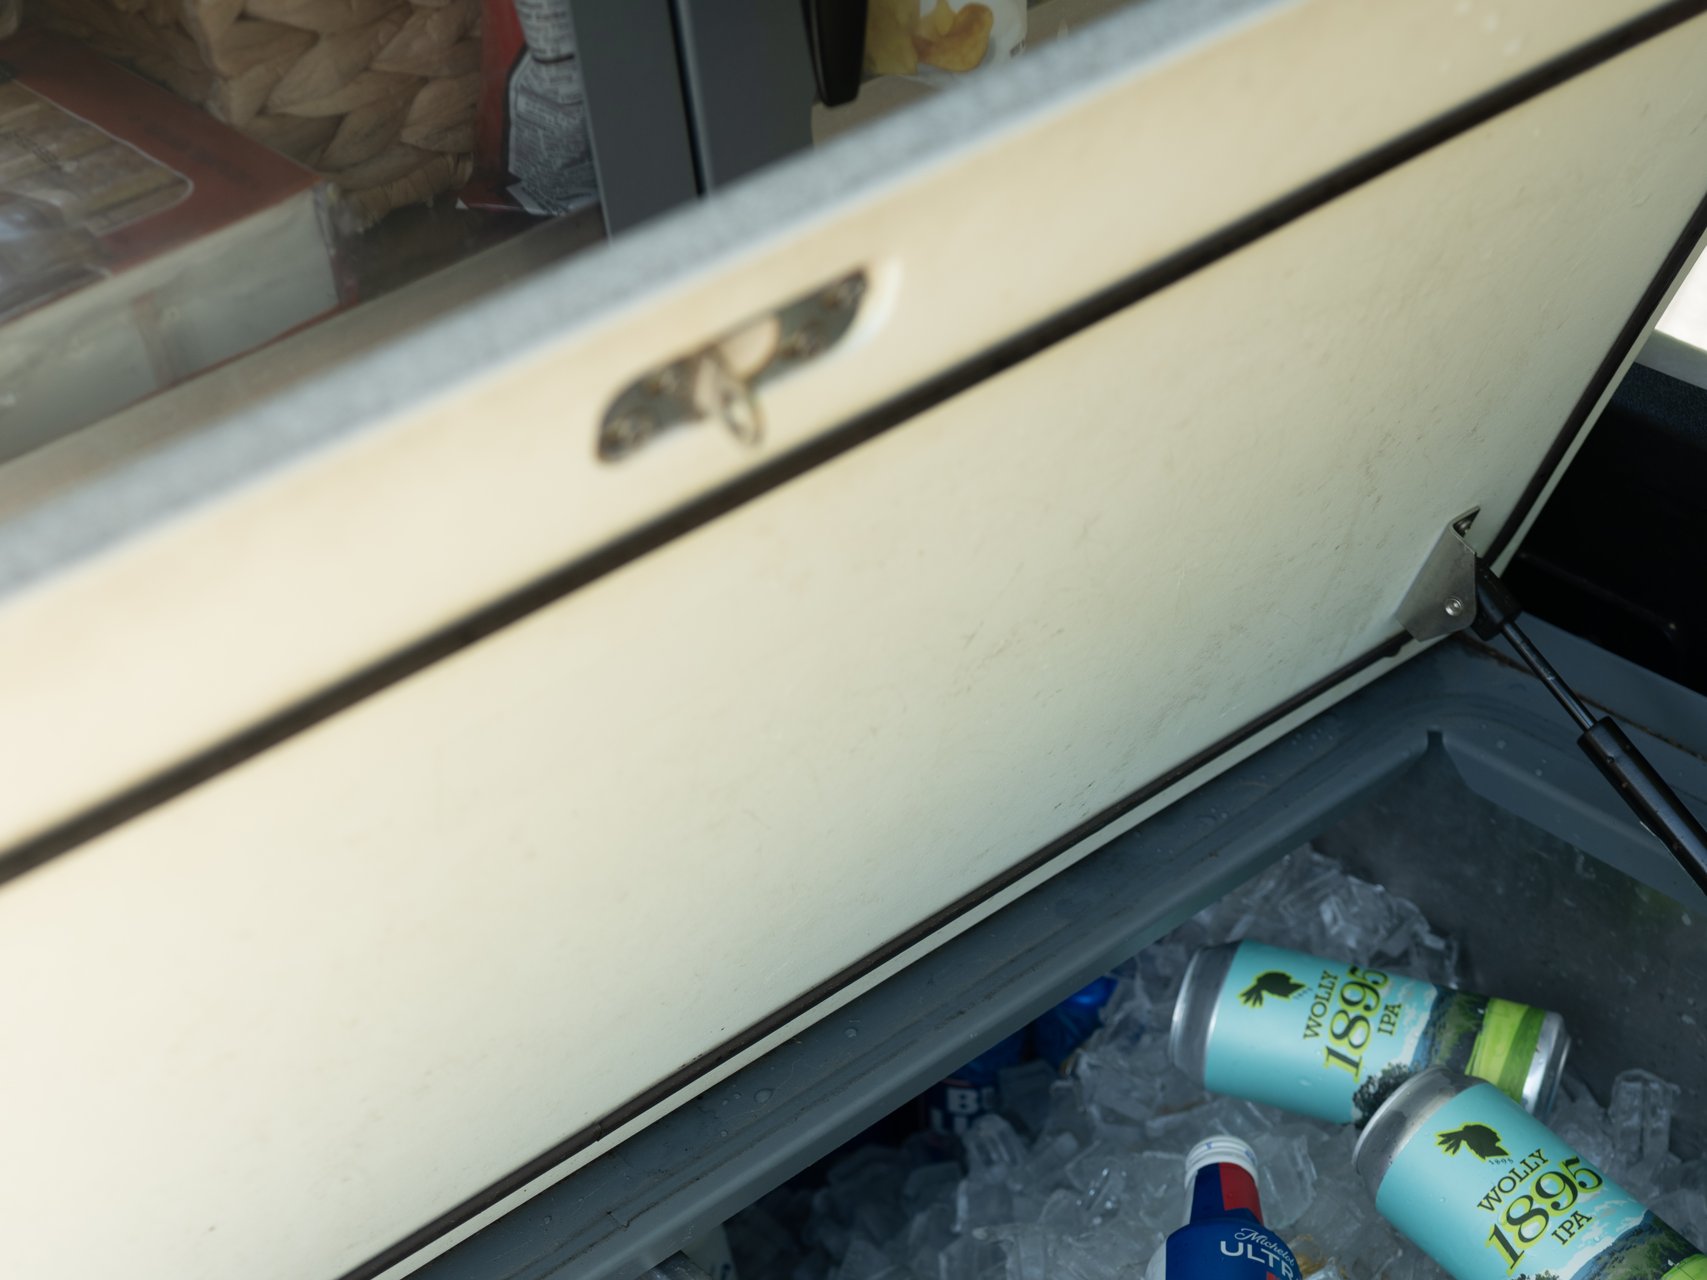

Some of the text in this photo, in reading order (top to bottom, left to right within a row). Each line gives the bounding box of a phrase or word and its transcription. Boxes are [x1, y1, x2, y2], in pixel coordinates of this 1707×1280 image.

[1303, 970, 1338, 1039] WOLLY
[1323, 964, 1389, 1080] 1895
[1377, 1002, 1403, 1036] IPA
[1477, 1148, 1550, 1212] WOLLY
[1487, 1156, 1604, 1272] 1895
[1551, 1210, 1593, 1246] IPA
